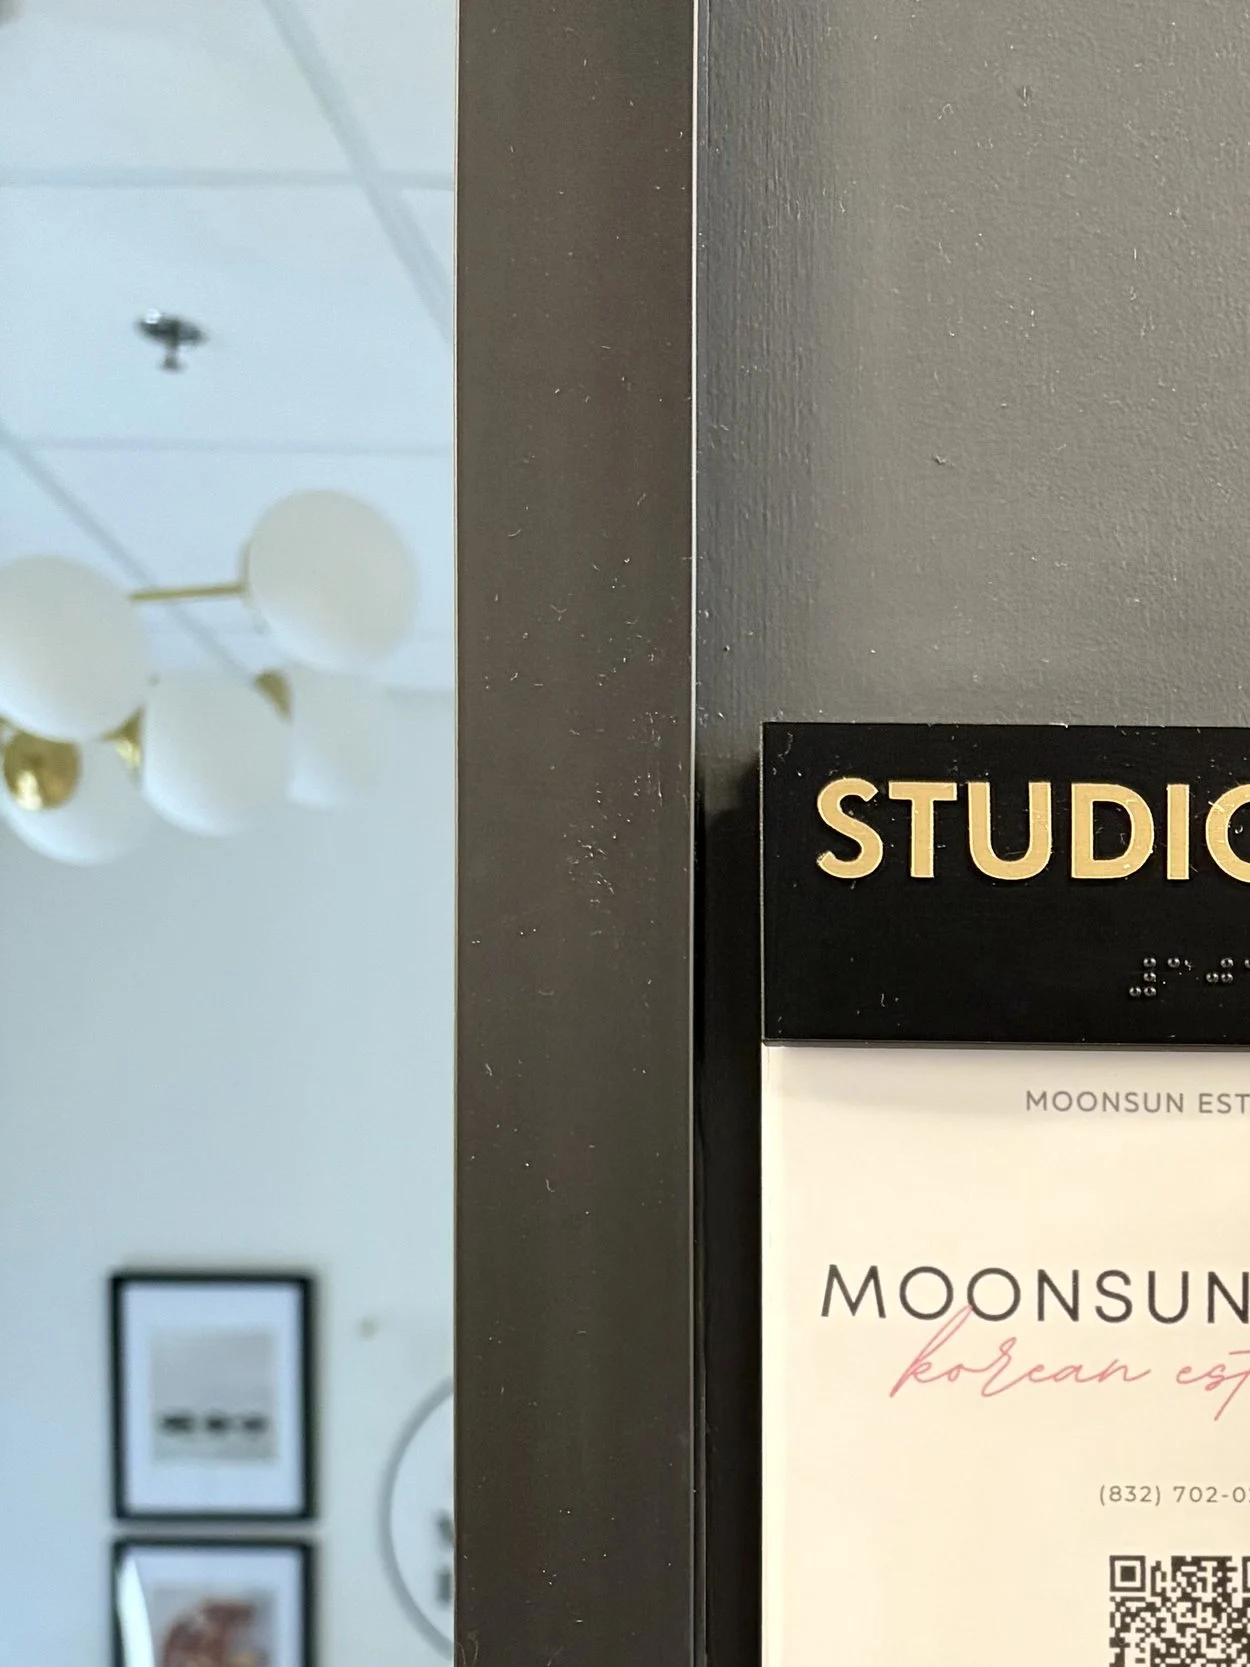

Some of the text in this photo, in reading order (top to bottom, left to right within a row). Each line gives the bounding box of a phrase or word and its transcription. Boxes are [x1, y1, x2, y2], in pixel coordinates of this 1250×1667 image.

[1025, 1088, 1185, 1115] MOONSUN
[820, 1263, 1250, 1325] MOONSUN
[889, 1304, 1152, 1398] korean
[1098, 1483, 1162, 1507] (832)
